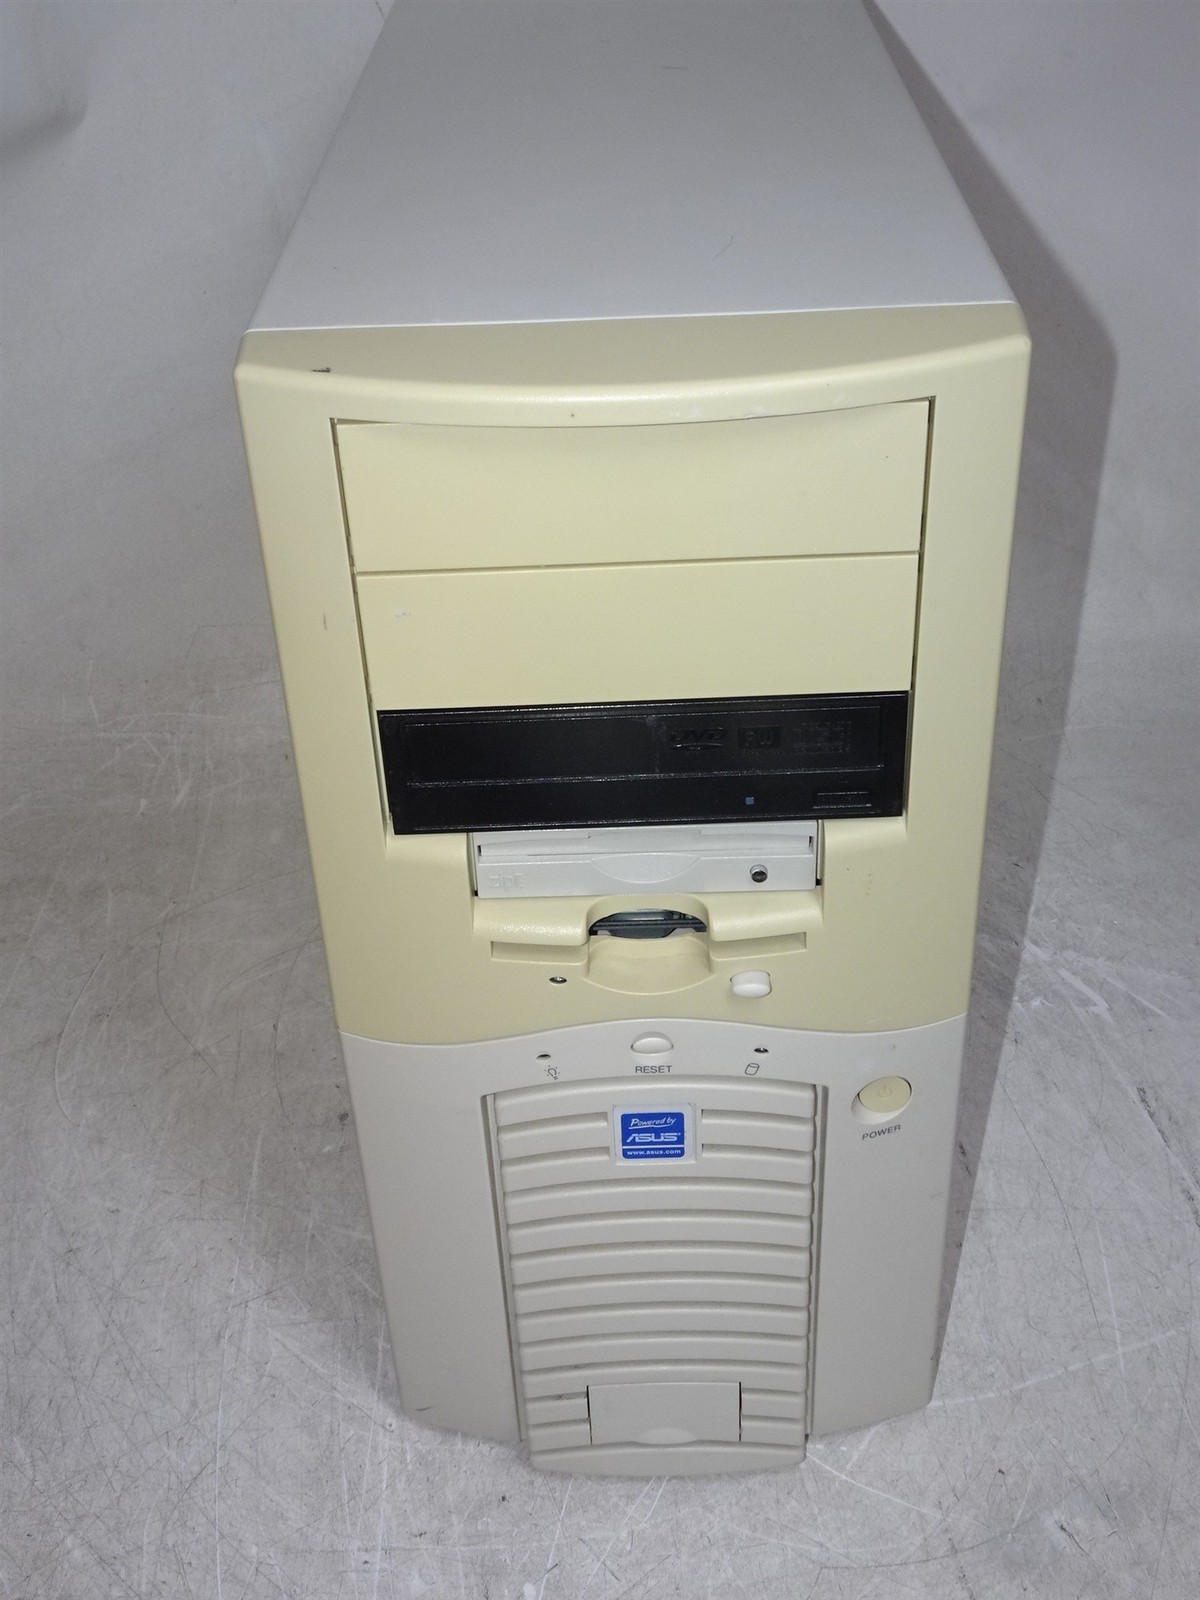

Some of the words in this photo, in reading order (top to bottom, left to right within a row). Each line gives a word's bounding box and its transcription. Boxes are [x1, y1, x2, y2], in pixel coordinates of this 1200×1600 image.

[635, 1065, 672, 1073] RESET
[630, 1117, 666, 1127] Powered
[666, 1116, 676, 1125] by
[626, 1132, 678, 1143] ASUS
[862, 1124, 901, 1140] POWER
